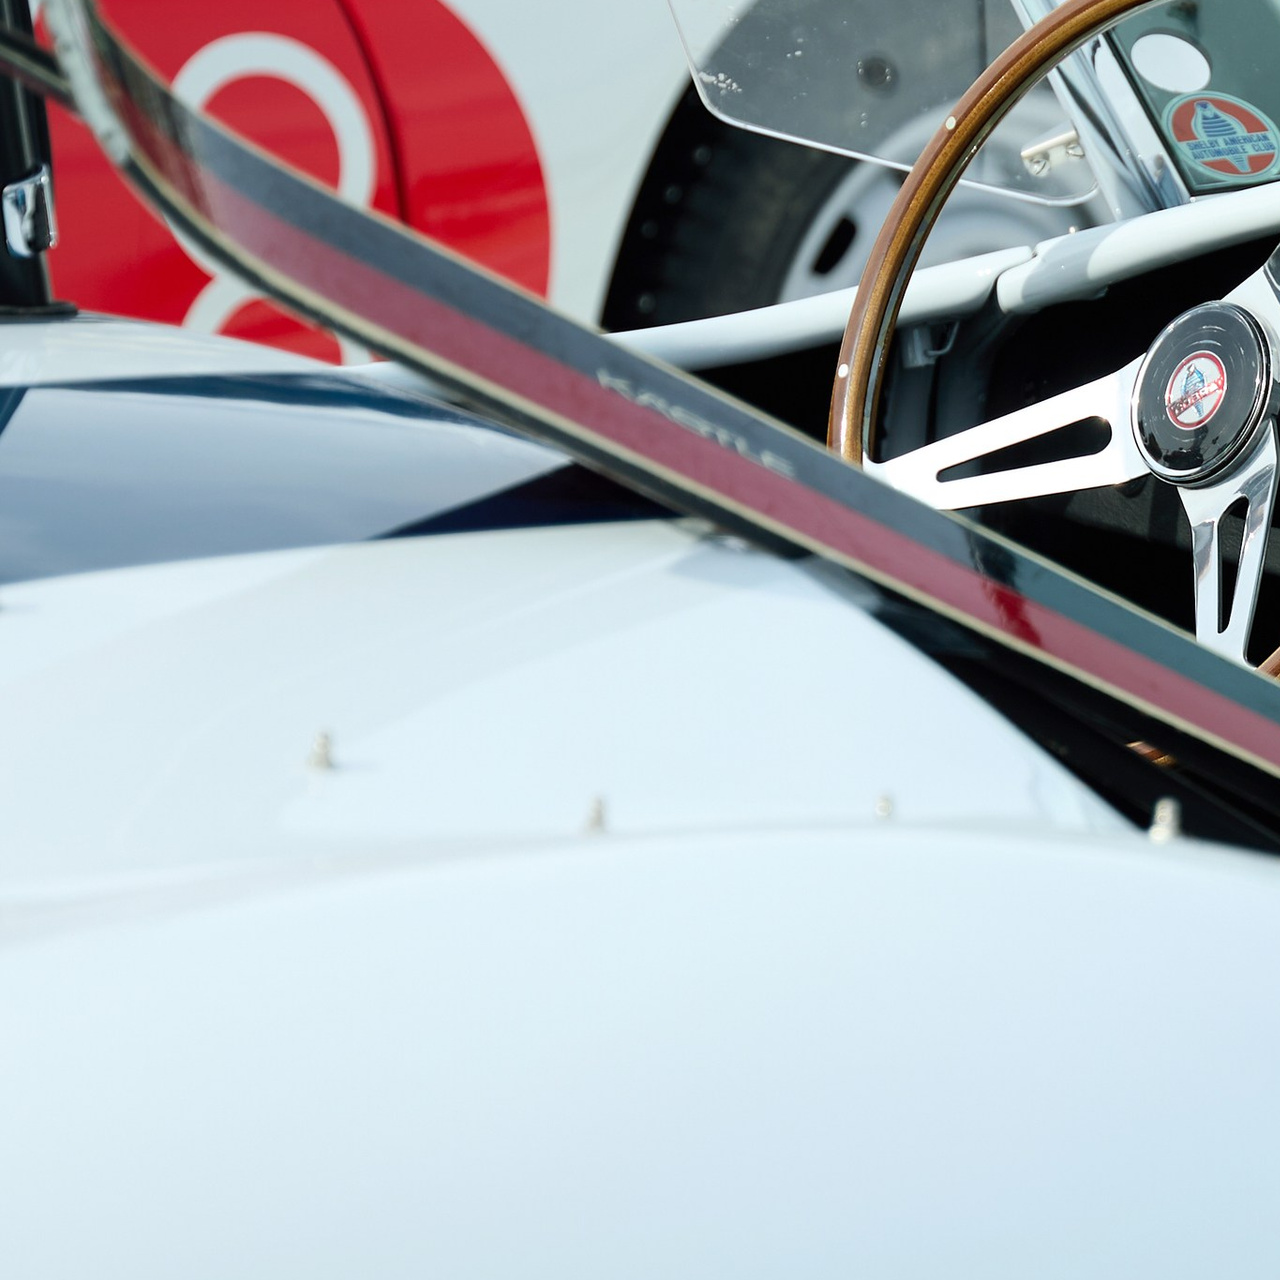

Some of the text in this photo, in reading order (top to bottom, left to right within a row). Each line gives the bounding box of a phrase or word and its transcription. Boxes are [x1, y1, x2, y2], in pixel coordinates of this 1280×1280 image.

[1187, 133, 1271, 150] SHELBY AMERICAN
[1191, 140, 1276, 160] AUTOMOBILE CLUB
